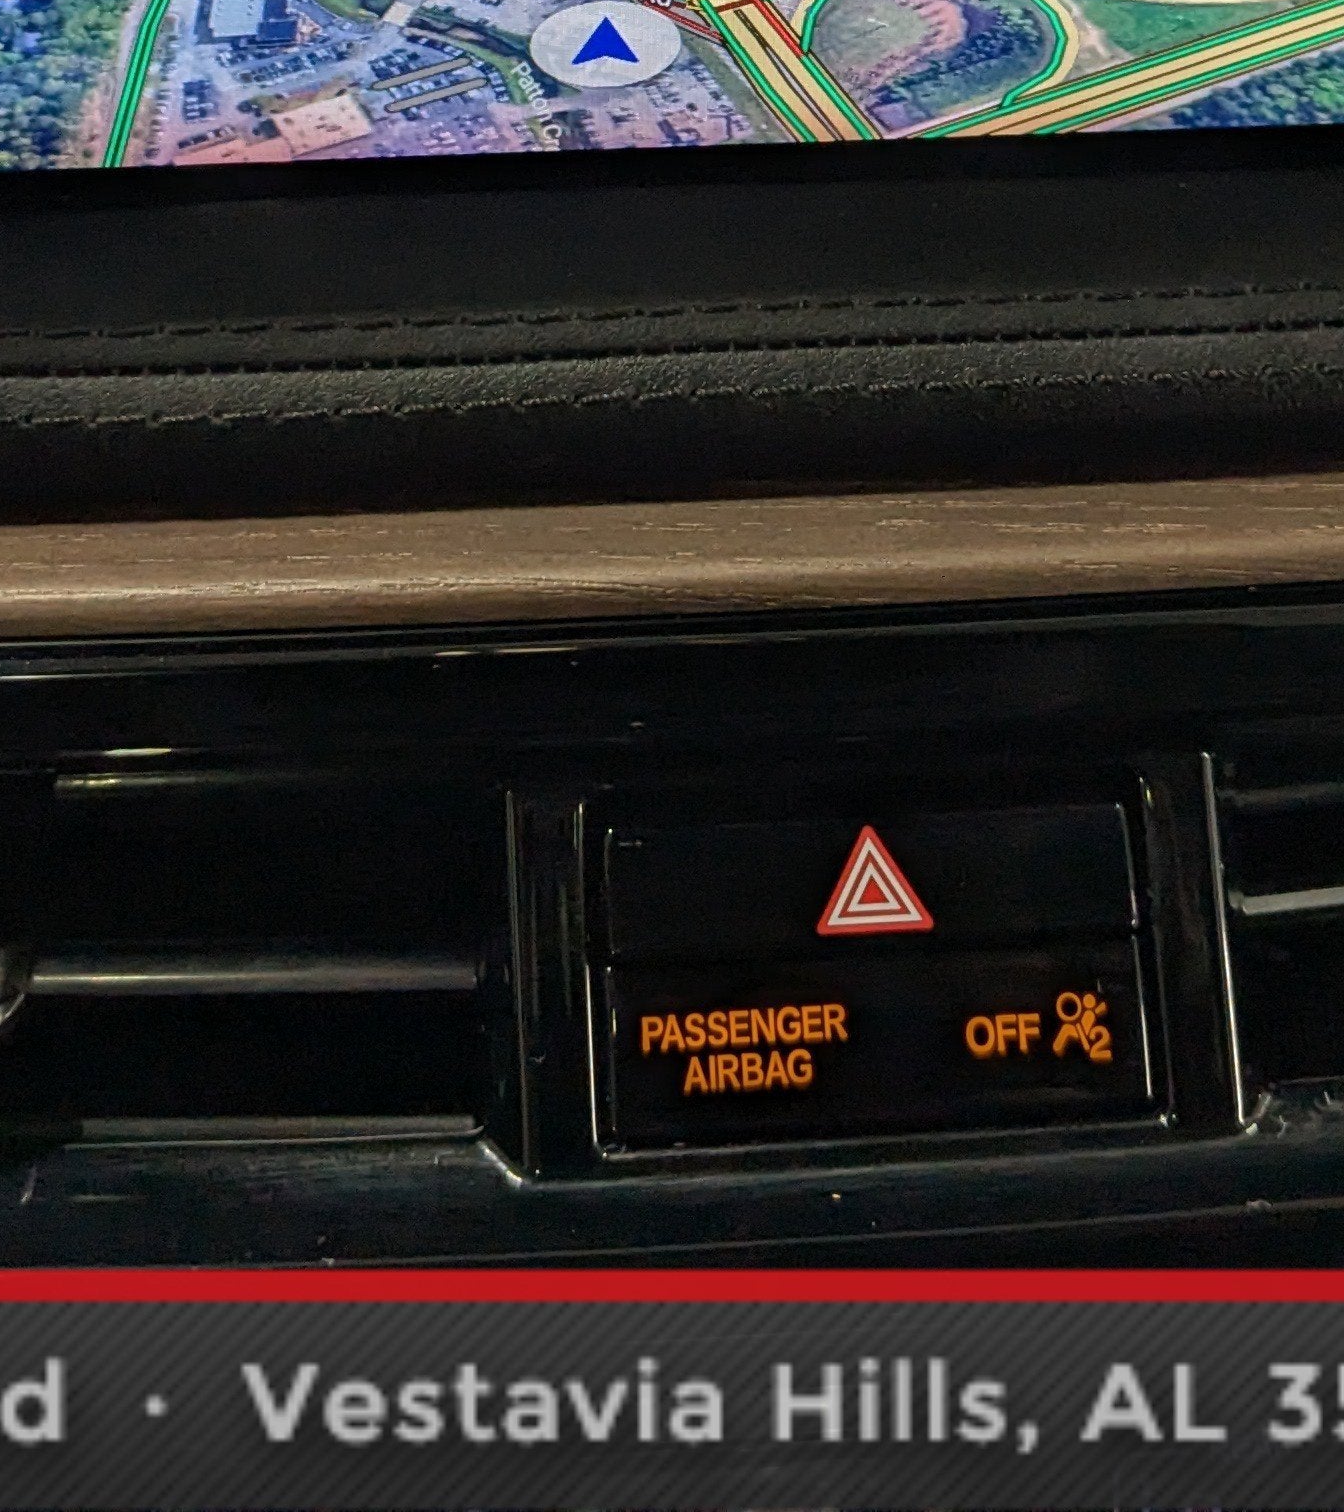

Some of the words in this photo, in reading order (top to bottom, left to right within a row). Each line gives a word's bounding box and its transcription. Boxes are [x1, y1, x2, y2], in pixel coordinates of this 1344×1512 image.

[641, 1002, 849, 1053] PASSENGER
[965, 1011, 1042, 1058] OFF
[683, 1049, 815, 1097] AIRBAG
